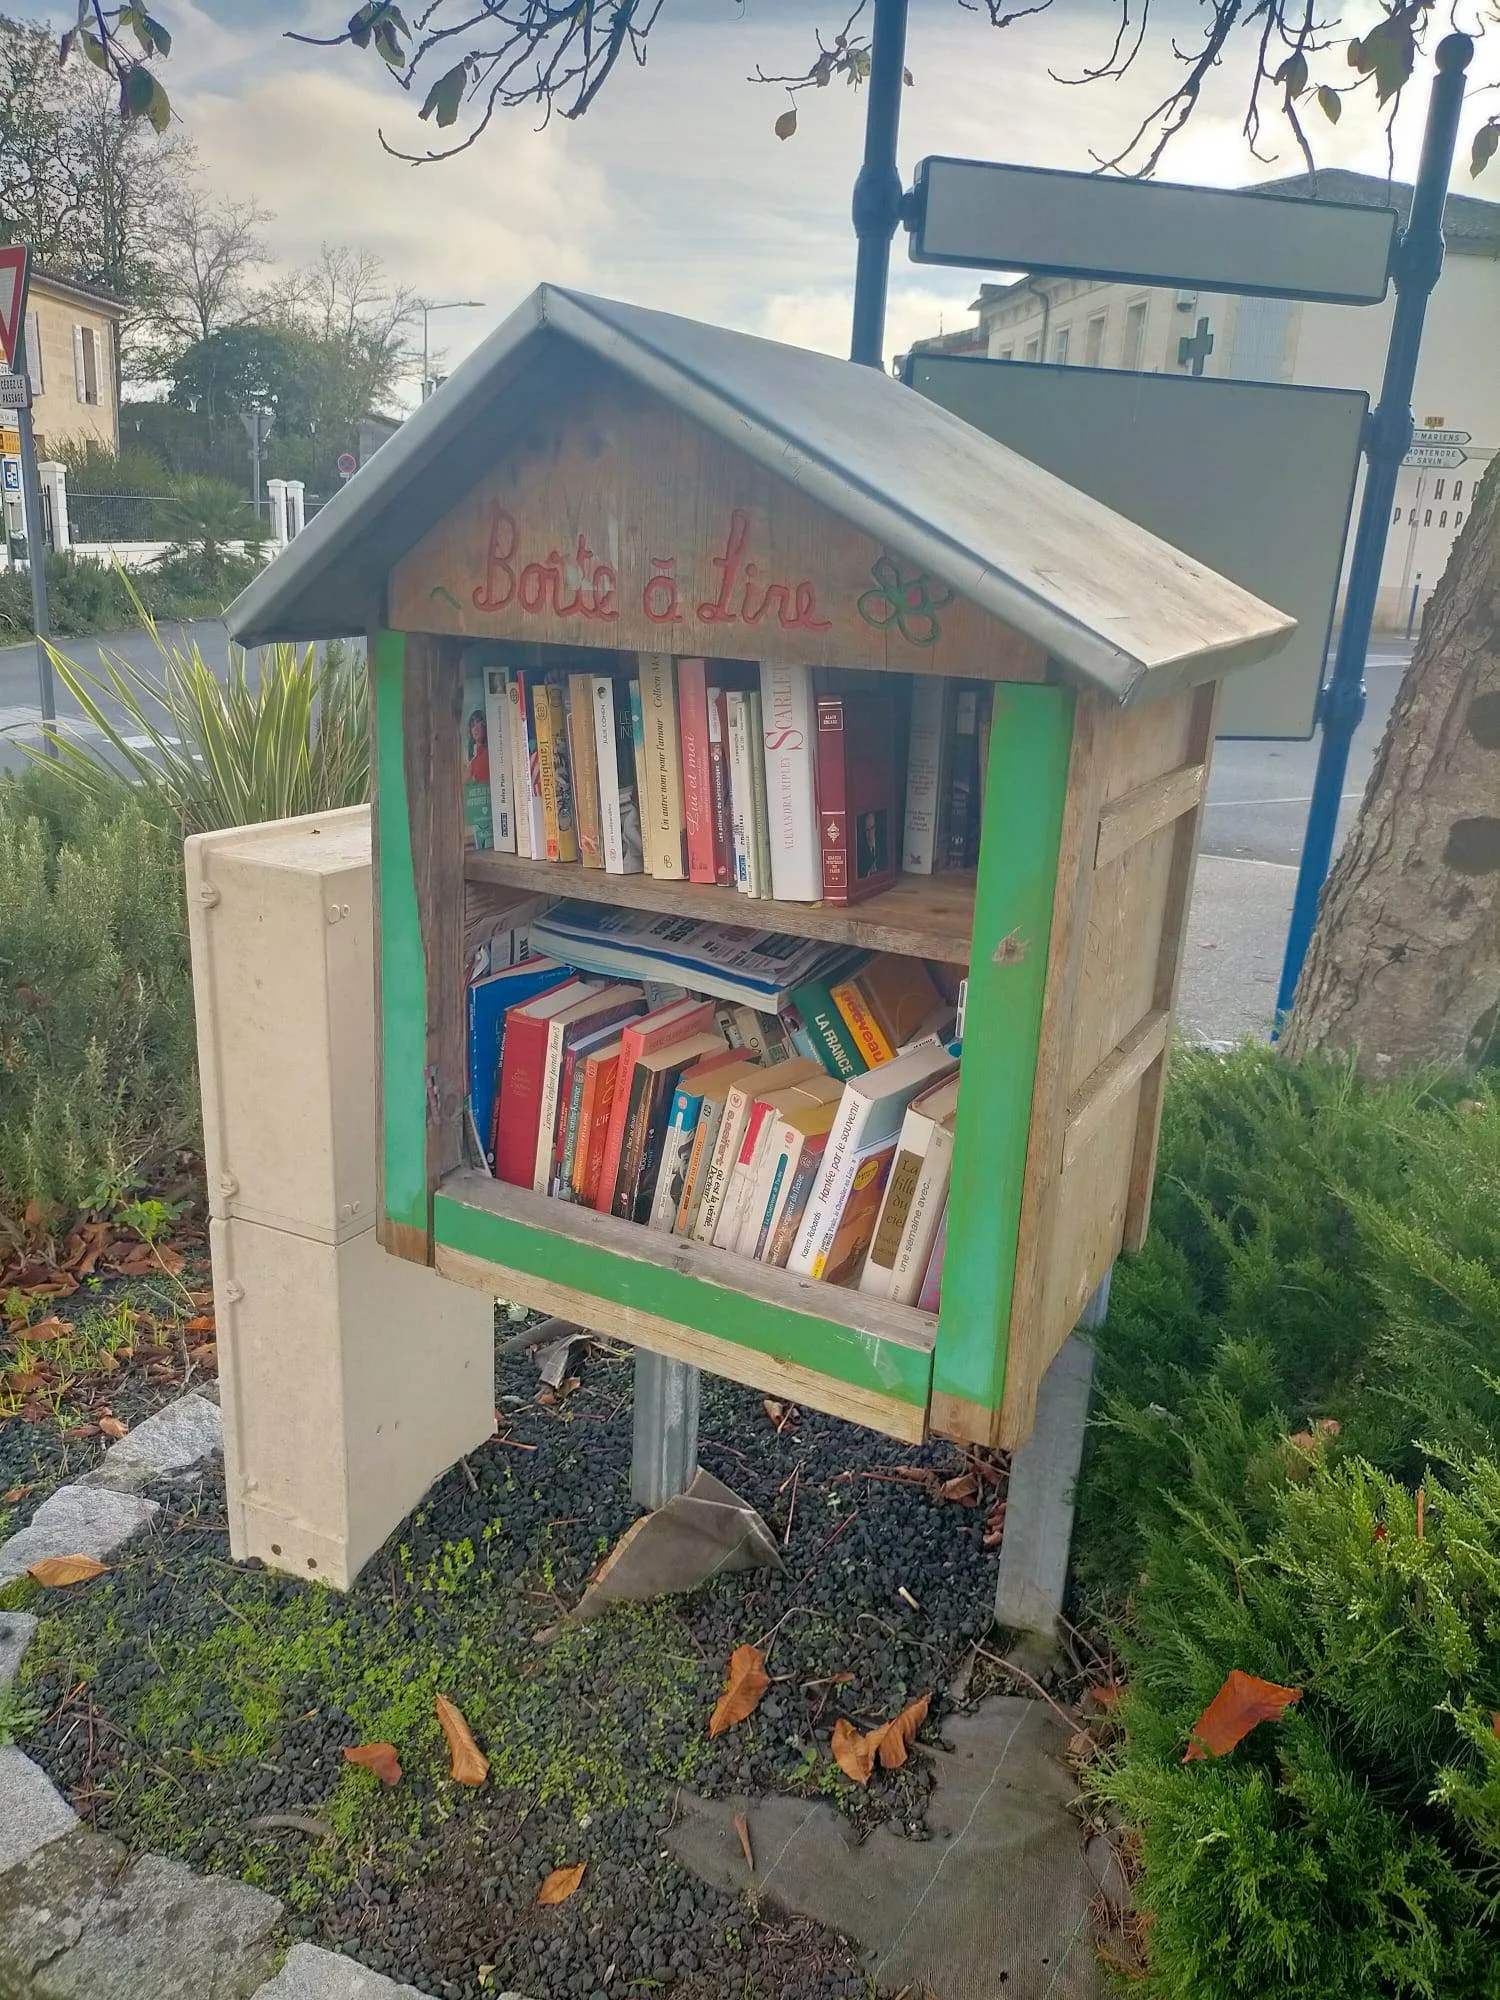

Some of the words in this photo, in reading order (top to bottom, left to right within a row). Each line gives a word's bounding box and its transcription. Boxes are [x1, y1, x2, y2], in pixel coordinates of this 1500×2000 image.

[3, 393, 24, 403] PASSAGE
[1421, 433, 1460, 441] MARIENS
[651, 676, 662, 707] Colleen
[765, 661, 804, 750] SCARLET
[653, 718, 664, 750] l'amour
[657, 752, 668, 772] pour
[684, 732, 696, 768] moi
[658, 774, 667, 792] nom
[686, 772, 697, 788] et
[779, 756, 792, 790] RIPLEY
[660, 794, 669, 816] autre
[685, 791, 700, 835] Lui
[660, 818, 670, 830] Un
[780, 794, 795, 849] ALEXANDRA
[840, 989, 884, 1064] nouveau
[814, 1013, 829, 1034] LA
[823, 1029, 853, 1075] FRANCE
[570, 1085, 581, 1110] Kramer
[568, 1111, 577, 1130] contre
[564, 1131, 574, 1156] Kramer
[818, 1171, 836, 1204] Hantée
[832, 1152, 844, 1172] par
[838, 1142, 846, 1153] le
[842, 1100, 860, 1143] souvenir
[700, 1164, 720, 1203] Docteur?
[711, 1181, 722, 1194] est
[715, 1169, 726, 1181] où
[709, 1194, 720, 1204] la
[788, 1192, 798, 1202] du
[799, 1237, 813, 1258] Karen
[808, 1210, 822, 1238] Robards
[899, 1254, 909, 1273] une
[905, 1208, 922, 1255] semaine
